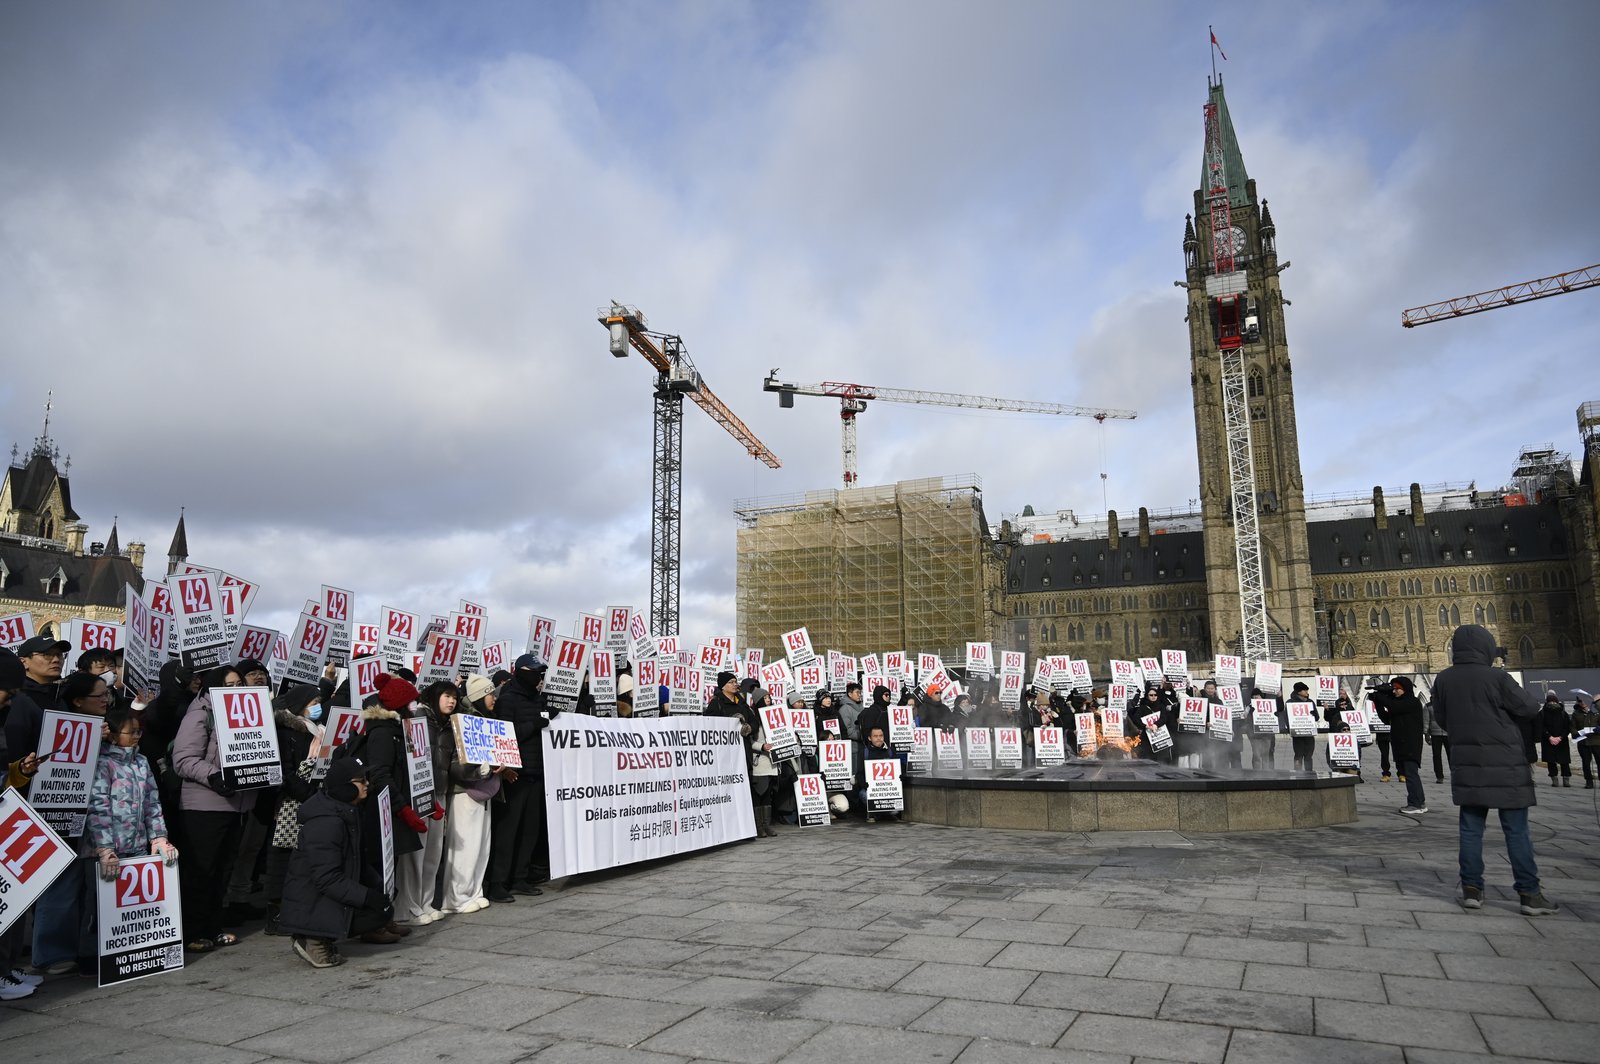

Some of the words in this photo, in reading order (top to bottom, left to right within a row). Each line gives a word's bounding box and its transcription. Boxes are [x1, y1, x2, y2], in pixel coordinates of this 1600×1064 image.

[185, 579, 210, 612] 42
[328, 592, 345, 620] 42
[133, 599, 147, 642] 20
[189, 614, 212, 625] MONTHS
[390, 612, 409, 639] 22
[613, 610, 626, 630] 53
[0, 618, 23, 646] 31
[185, 627, 207, 636] WAITING
[208, 624, 219, 633] FOR
[363, 626, 379, 642] 19
[458, 616, 476, 641] 31
[586, 619, 599, 642] 15
[632, 616, 645, 639] 68
[85, 625, 113, 653] 36
[183, 636, 195, 647] IRCC
[195, 632, 223, 644] RESPONSE
[243, 631, 268, 660] 39
[304, 622, 326, 654] 32
[389, 639, 407, 648] MONTHS
[790, 633, 804, 649] 43
[435, 639, 456, 666] 31
[660, 639, 674, 653] 20
[972, 646, 985, 658] 70
[191, 651, 197, 659] NO
[300, 652, 317, 663] MONTHS
[485, 646, 500, 667] 28
[561, 642, 580, 668] 11
[704, 648, 720, 666] 33
[889, 655, 900, 668] 27
[1007, 654, 1020, 666] 36
[1169, 652, 1181, 664] 38
[1222, 657, 1234, 668] 32
[292, 661, 310, 671] WAITING
[595, 654, 609, 676] 71
[1041, 663, 1050, 676] 28
[1054, 658, 1065, 670] 37
[1073, 662, 1085, 674] 90
[1117, 662, 1130, 673] 39
[1144, 660, 1155, 670] 41
[298, 670, 319, 682] RESPONSE
[361, 662, 380, 693] 40
[430, 668, 448, 676] MONTHS
[640, 662, 654, 685] 53
[675, 666, 685, 688] 34
[765, 664, 782, 681] 30
[803, 668, 818, 684] 55
[551, 676, 568, 685] WAITING
[1006, 675, 1018, 688] 31
[1321, 678, 1333, 688] 37
[556, 685, 578, 694] RESPONSE
[770, 684, 782, 697] 30
[1223, 688, 1236, 700] 38
[230, 693, 258, 727] 40
[1188, 700, 1201, 712] 37
[1215, 707, 1227, 719] 37
[1258, 701, 1271, 712] 40
[1295, 705, 1308, 716] 31
[769, 709, 784, 728] 41
[794, 712, 809, 728] 24
[894, 709, 908, 725] 34
[1348, 712, 1360, 723] 20
[463, 715, 484, 732] STOP
[487, 720, 506, 736] THE
[54, 721, 87, 762] 20
[234, 731, 262, 740] MONTHS
[411, 723, 425, 756] 40
[550, 729, 581, 749] WE
[586, 730, 645, 749] DEMAND
[649, 732, 658, 747] A
[658, 731, 698, 746] TIMELY
[701, 730, 741, 746] DECISION
[915, 730, 927, 744] 35
[973, 730, 985, 744] 36
[1002, 730, 1016, 744] 21
[1043, 730, 1056, 743] 14
[1336, 735, 1351, 747] 22
[228, 742, 256, 752] WAITING
[258, 741, 270, 749] FOR
[828, 744, 844, 761] 40
[225, 753, 240, 763] IRCC
[241, 750, 275, 761] RESPONSE
[617, 751, 672, 770] DELAYED
[675, 752, 689, 767] BY
[691, 750, 714, 766] IRCC
[51, 768, 80, 778] MONTHS
[234, 768, 242, 776] NO
[243, 766, 268, 775] TIMELINE
[875, 763, 894, 780] 22
[40, 780, 70, 790] WAITING
[71, 782, 85, 791] FOR
[238, 777, 246, 785] NO
[556, 784, 627, 801] REASONABLE
[628, 780, 672, 794] TIMELINES
[678, 776, 718, 790] PROCEDURAL
[718, 774, 744, 785] FAIRNESS
[803, 778, 818, 795] 43
[33, 794, 50, 803] IRCC
[50, 794, 86, 803] RESPONSE
[586, 806, 617, 822] Délais
[619, 801, 673, 817] raisonnables
[679, 796, 698, 810] Équité
[699, 794, 731, 809] procédurale
[630, 820, 672, 841] 给出时限
[680, 813, 712, 833] 程序公平
[0, 819, 48, 877] 11
[120, 862, 159, 906] 20
[122, 907, 160, 922] MONTHS
[112, 921, 150, 936] WAITING
[154, 917, 170, 928] FOR
[106, 937, 127, 950] IRCC
[129, 928, 176, 945] RESPONSE
[116, 956, 127, 965] NO
[120, 966, 131, 975] NO
[132, 958, 166, 972] RESULTS
